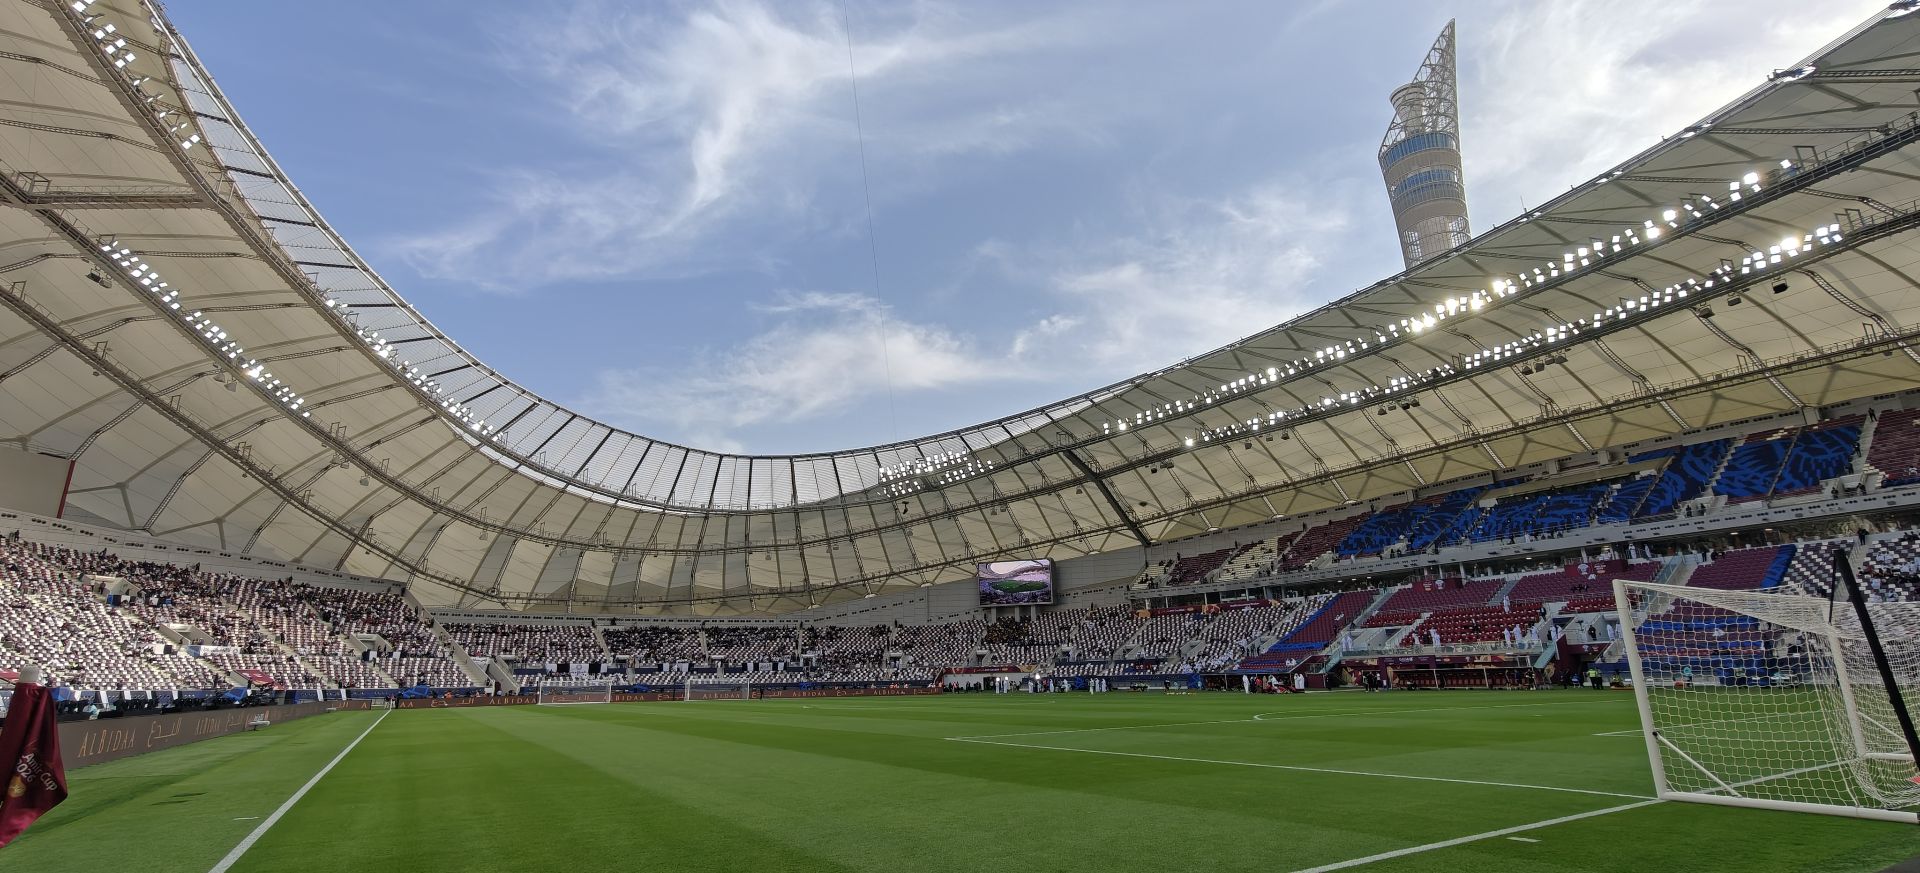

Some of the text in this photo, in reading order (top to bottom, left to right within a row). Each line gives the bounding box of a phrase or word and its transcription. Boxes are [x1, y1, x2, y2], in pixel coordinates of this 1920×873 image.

[77, 728, 136, 758] ALBIDAA
[22, 752, 58, 791] Amir Cup
